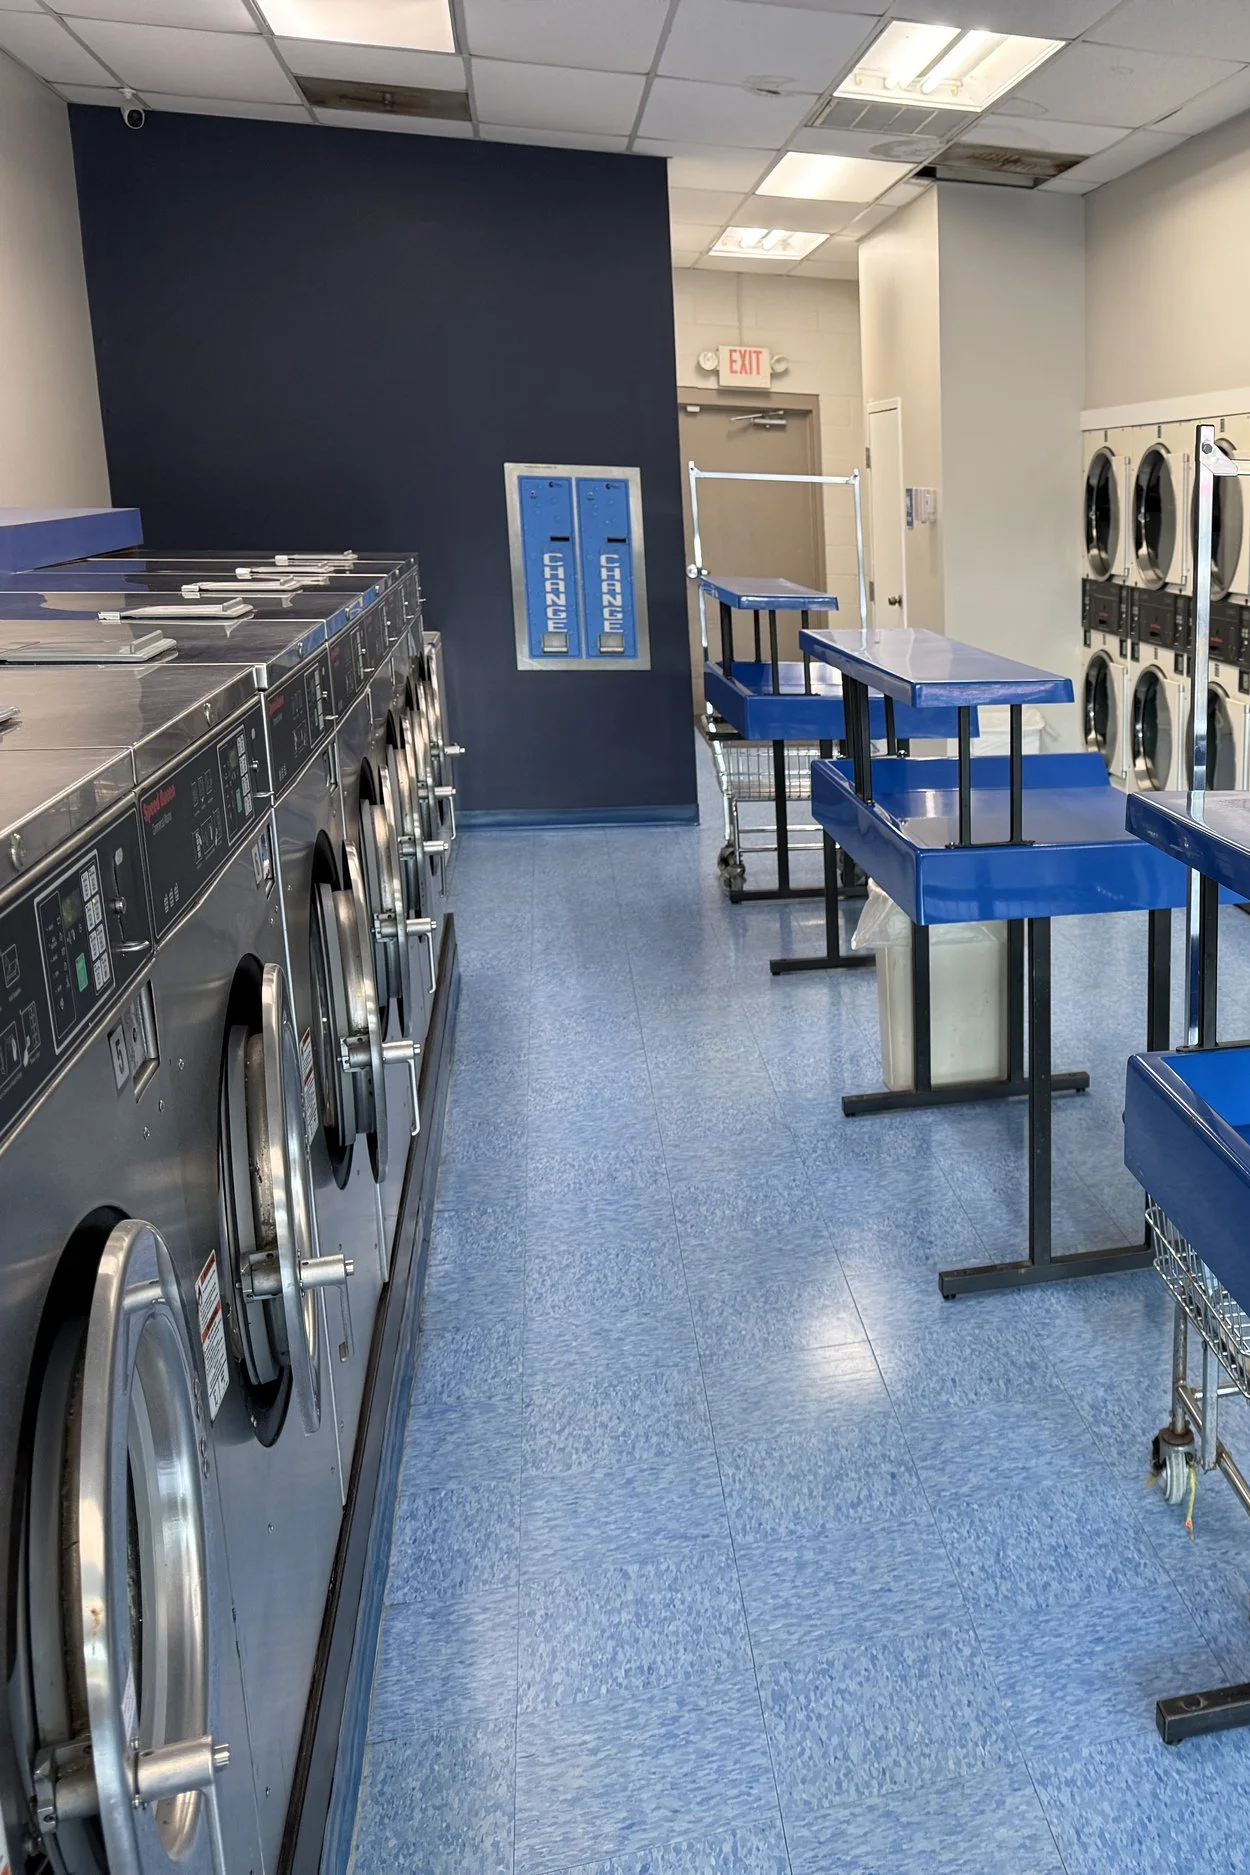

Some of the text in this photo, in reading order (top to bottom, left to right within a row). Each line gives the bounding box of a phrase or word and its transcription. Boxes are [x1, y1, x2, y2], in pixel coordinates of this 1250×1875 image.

[728, 349, 763, 375] EXIT
[543, 553, 568, 632] CHANGE
[600, 554, 624, 633] CHANGE
[115, 1038, 125, 1074] 5
